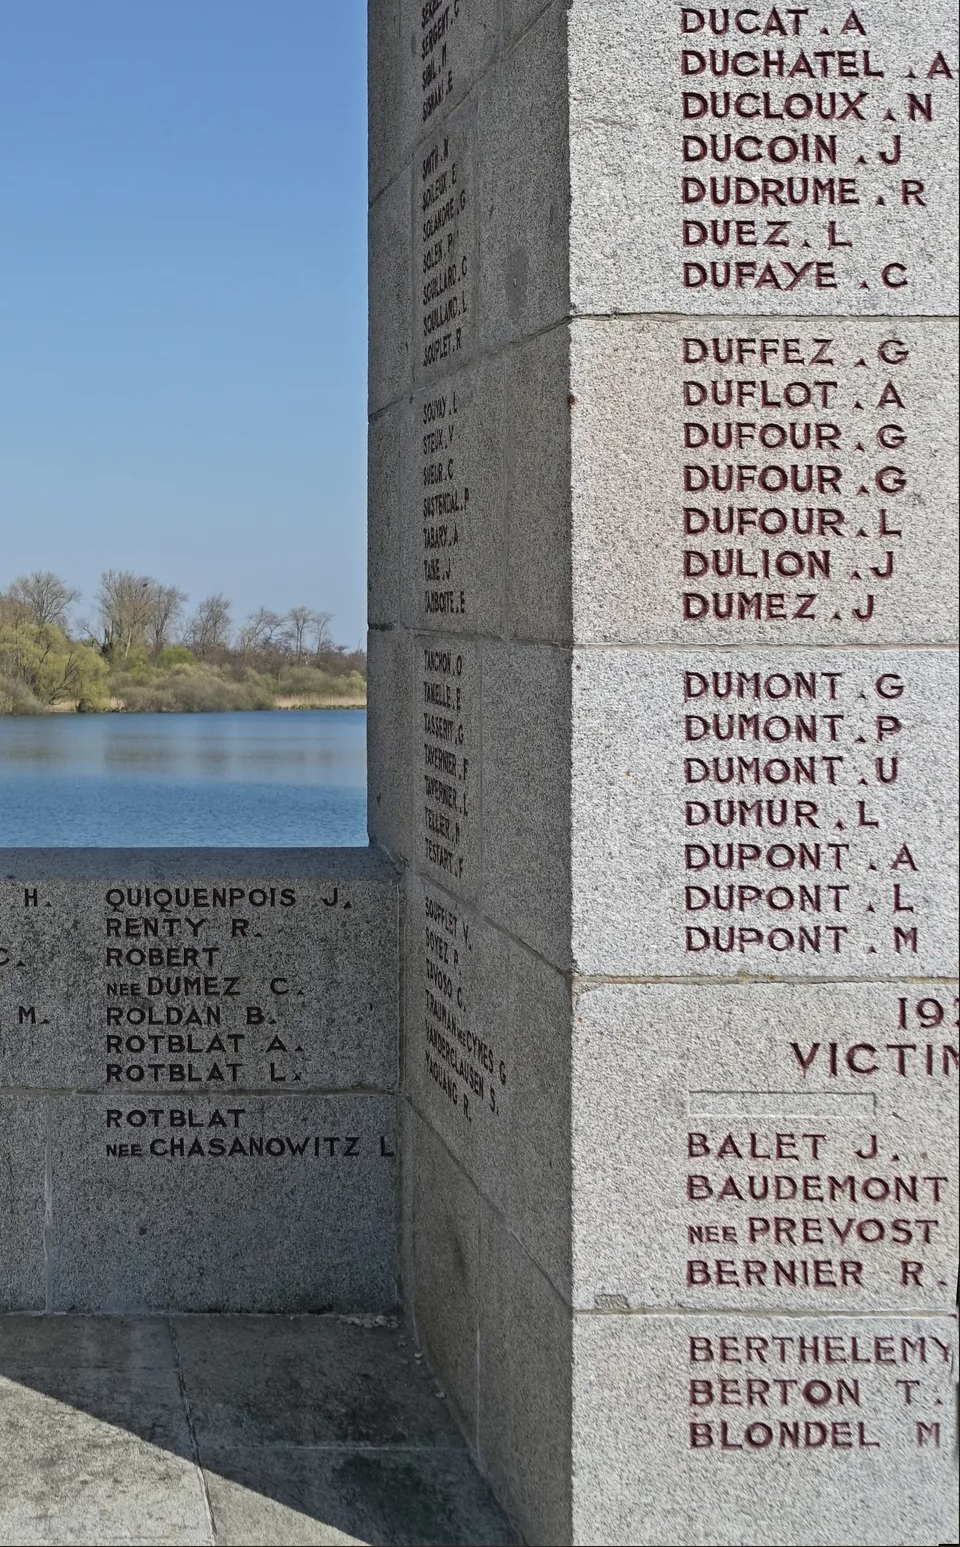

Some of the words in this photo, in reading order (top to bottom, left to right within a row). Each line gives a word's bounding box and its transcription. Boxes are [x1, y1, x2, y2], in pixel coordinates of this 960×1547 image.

[105, 887, 297, 914] QUIQUENPOIS
[105, 917, 208, 939] RENTY
[105, 946, 220, 968] ROBERT
[106, 982, 141, 997] NEE
[146, 976, 241, 997] DUMEZ
[106, 1005, 222, 1027] ROLDAN
[106, 1033, 245, 1055] ROTBLAT
[105, 1062, 243, 1084] ROTBLAT
[105, 1108, 246, 1129] ROTBLAT
[105, 1143, 142, 1158] NEE
[148, 1135, 360, 1158] CHASANOWITZ
